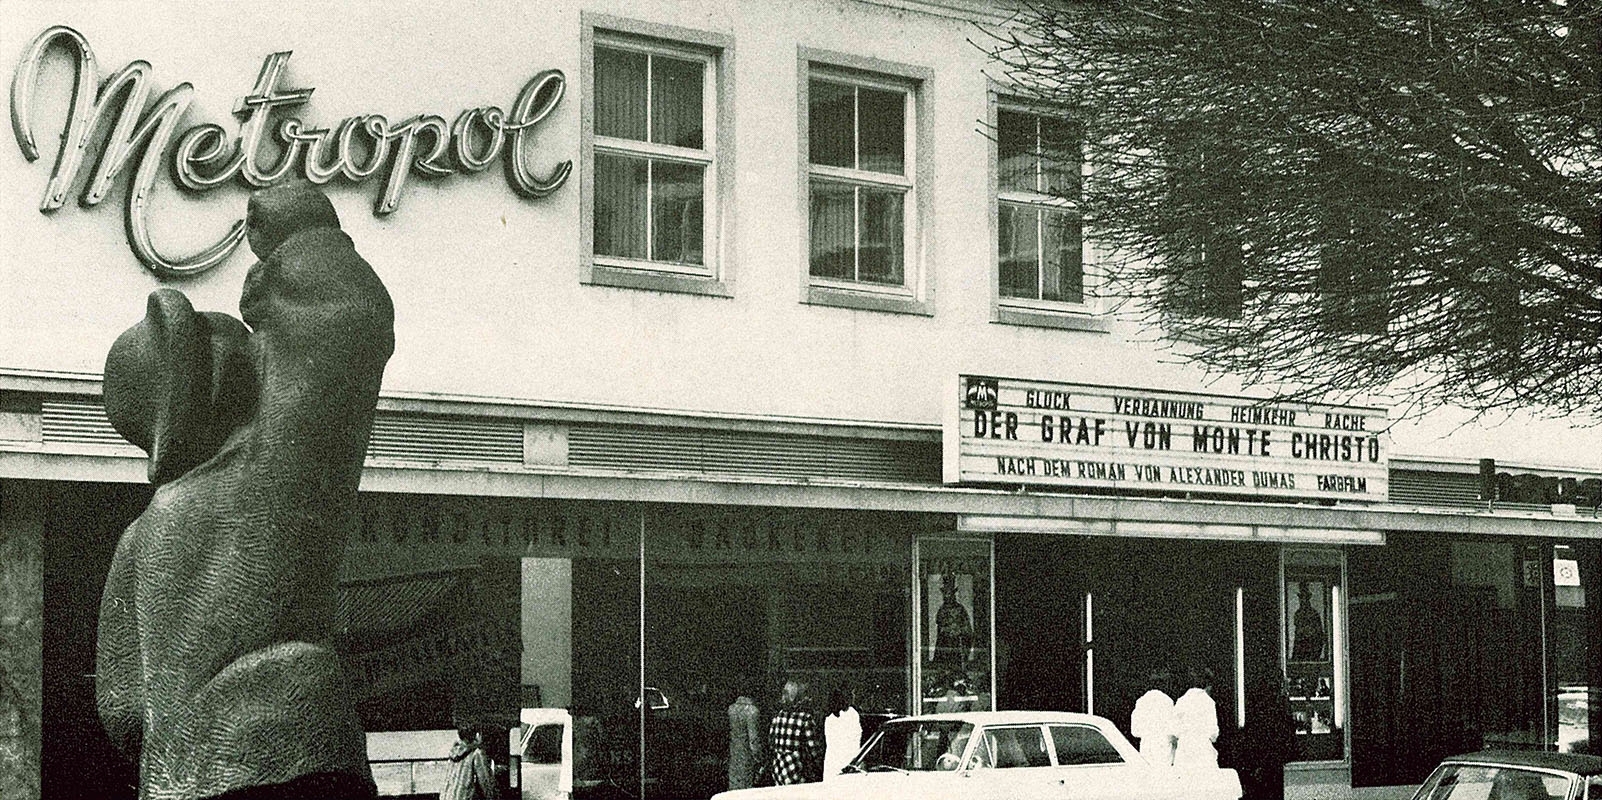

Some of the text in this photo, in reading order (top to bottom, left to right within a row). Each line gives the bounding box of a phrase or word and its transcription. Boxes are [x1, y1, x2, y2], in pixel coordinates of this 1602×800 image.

[10, 25, 573, 281] Metropol
[1114, 396, 1203, 420] VERBANNUNG
[1232, 406, 1296, 427] HEIMKEHR
[1325, 413, 1366, 431] RACHE
[974, 410, 1379, 463] DER GRAF VON MONTE CHRISTO
[998, 457, 1367, 493] NACH DEM ROMAN VON ALEXANDER DUMAS FARBFILM
